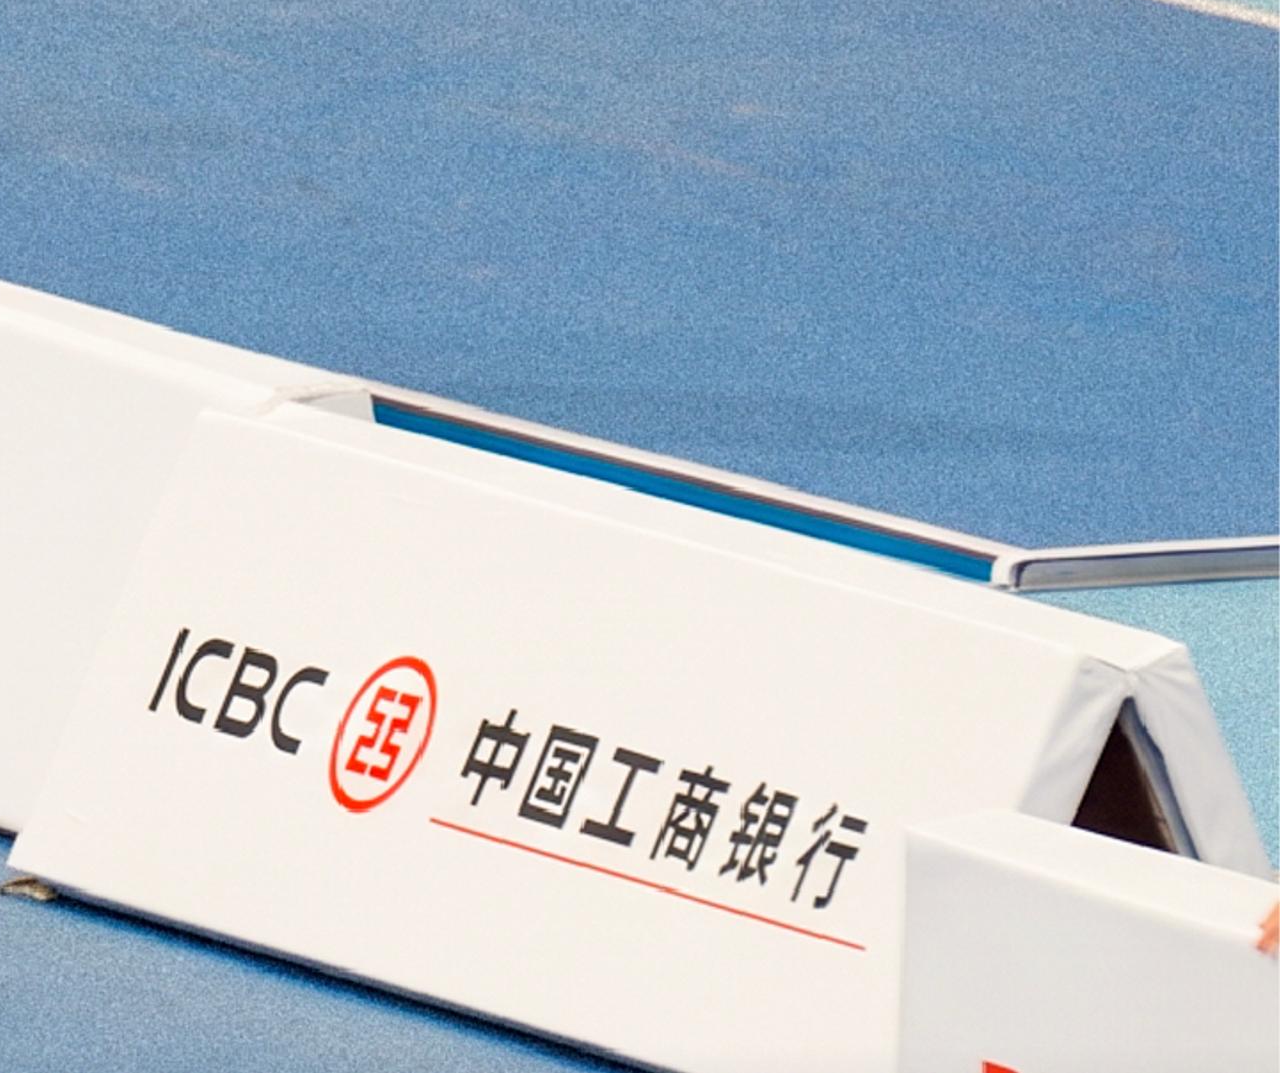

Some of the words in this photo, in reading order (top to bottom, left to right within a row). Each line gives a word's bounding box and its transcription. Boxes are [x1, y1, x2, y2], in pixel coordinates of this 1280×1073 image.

[148, 626, 329, 756] ICBC
[460, 708, 869, 910] 中国工商银行
